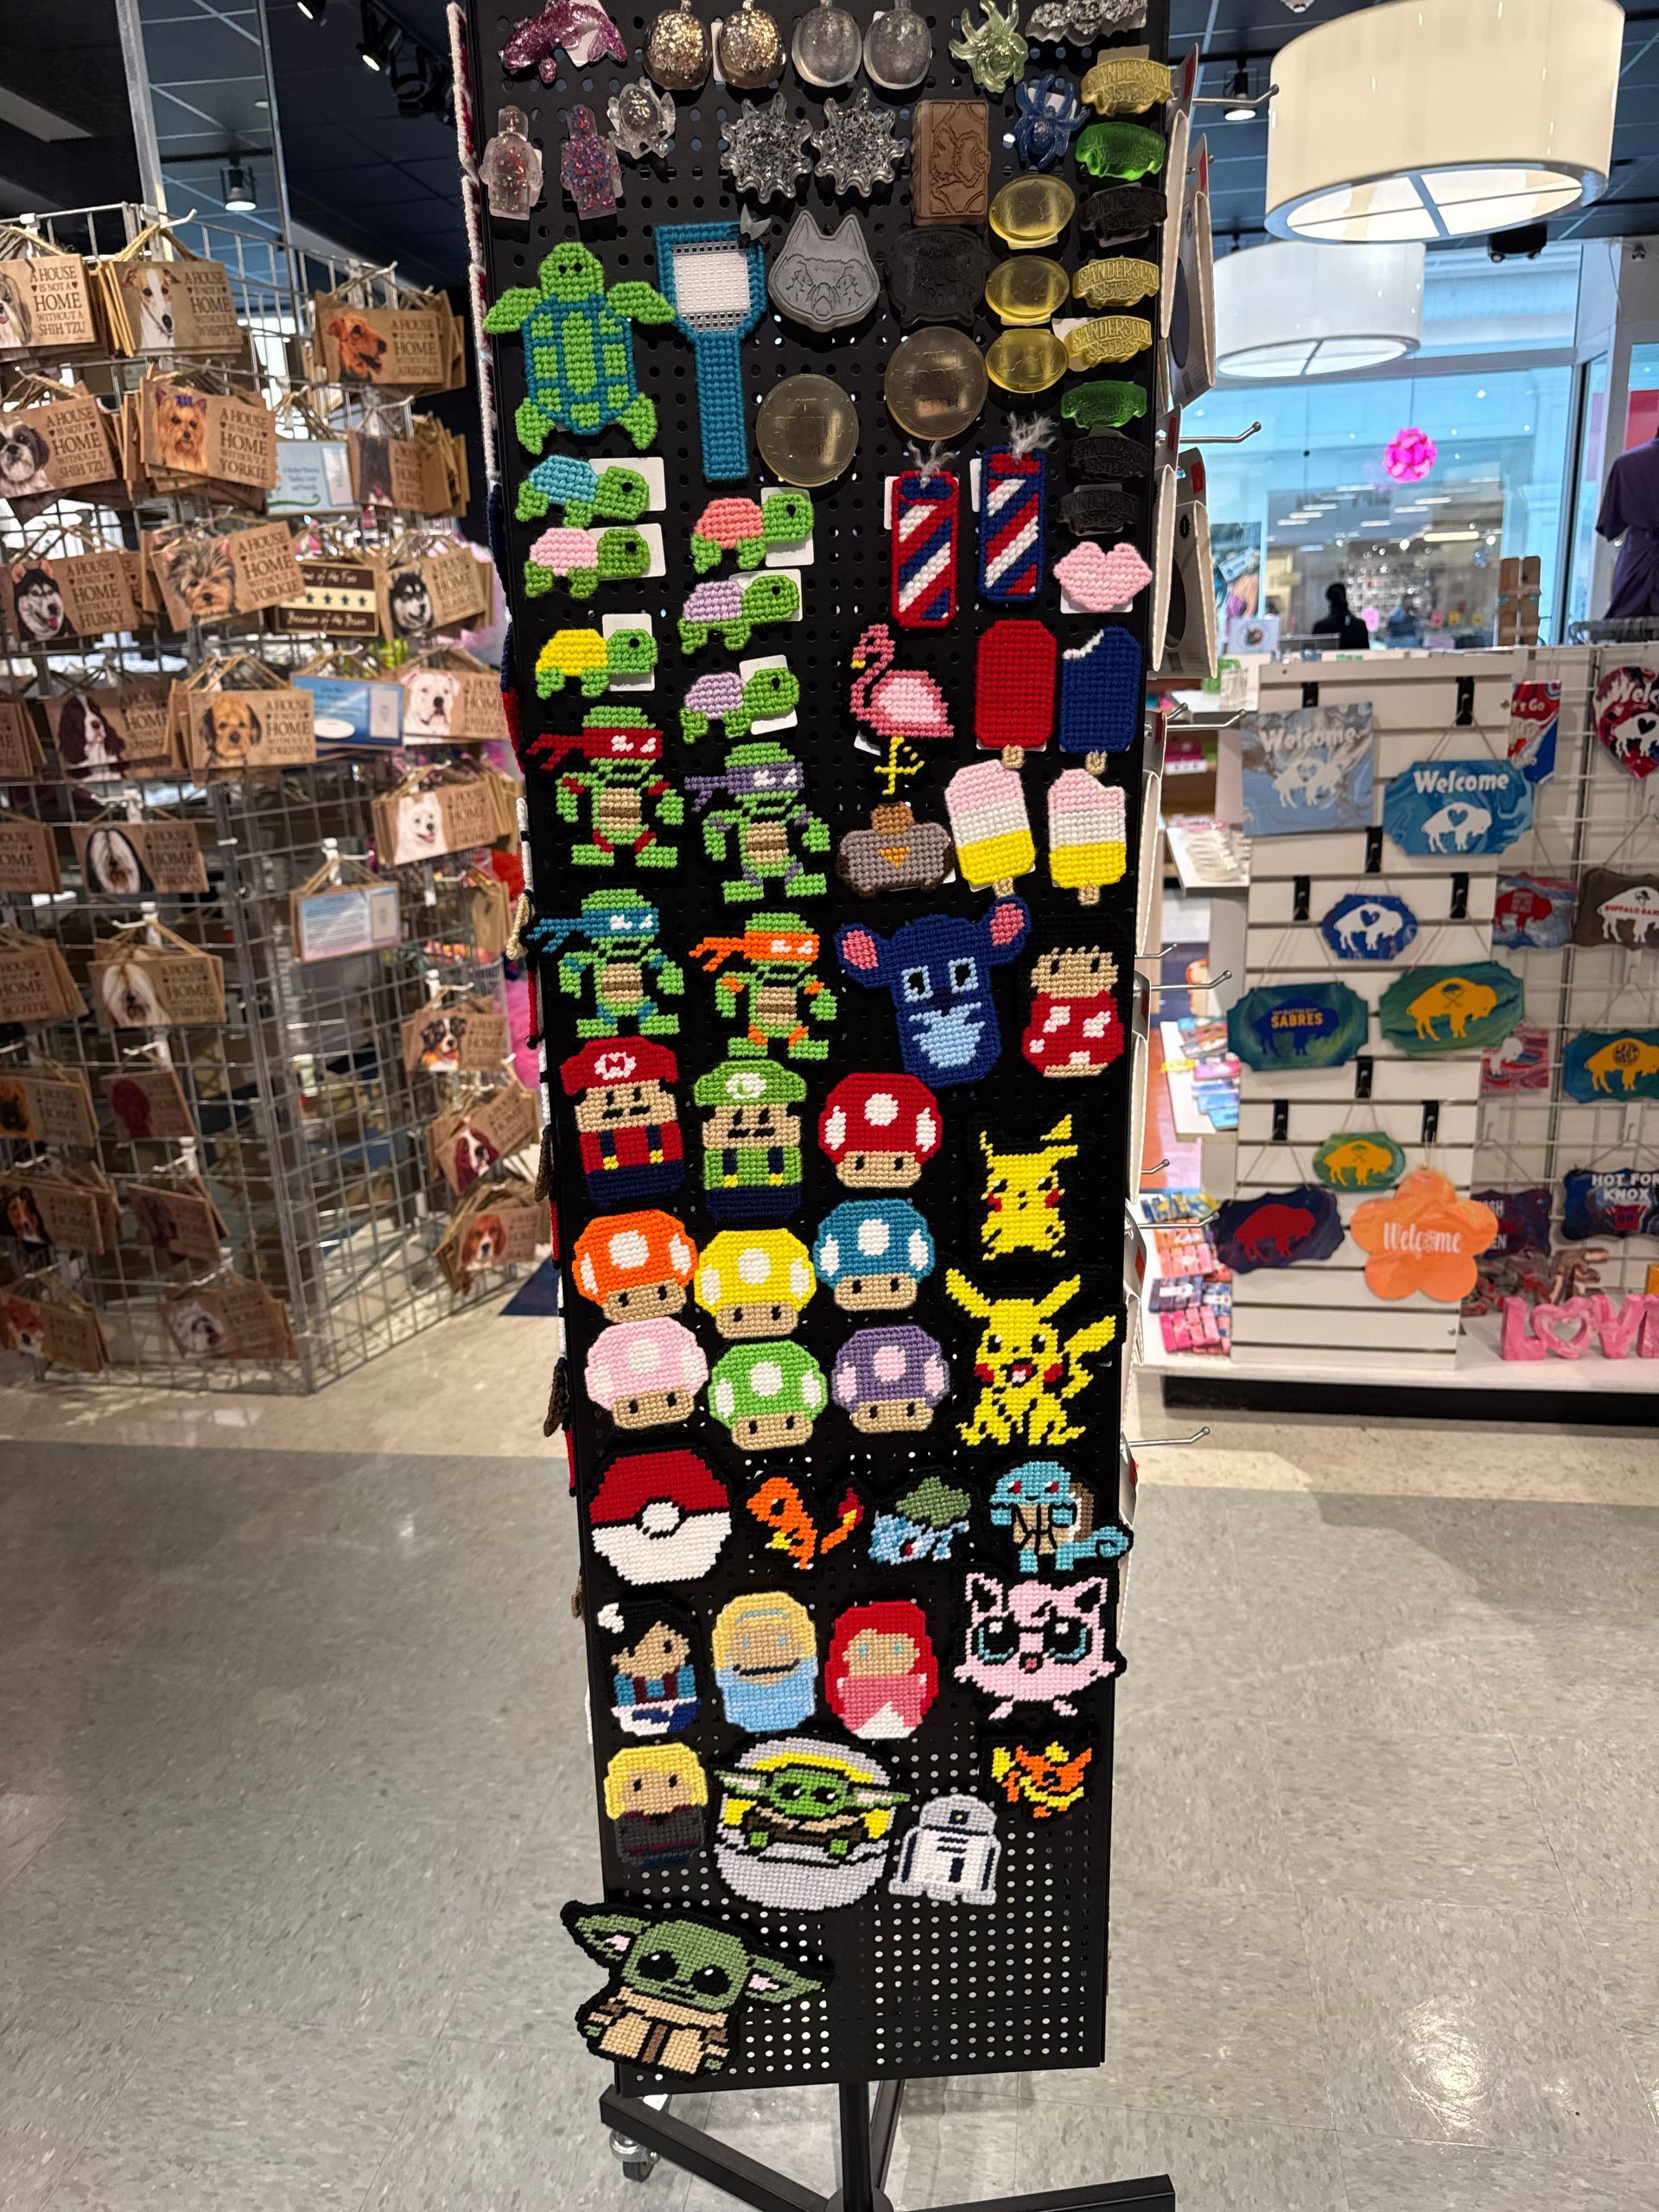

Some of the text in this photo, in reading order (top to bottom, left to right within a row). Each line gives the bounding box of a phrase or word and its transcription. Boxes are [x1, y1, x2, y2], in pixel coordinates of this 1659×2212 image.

[1087, 60, 1170, 93] SANDERSON
[39, 265, 78, 283] HOUSE
[1078, 261, 1158, 289] SANDERSON
[1094, 280, 1144, 298] SISTERS
[33, 292, 82, 312] HOME
[188, 296, 232, 314] HOME
[36, 312, 76, 322] WITHOUT
[38, 321, 86, 337] SHIH TZU
[1072, 318, 1148, 352] SANDERSON
[393, 341, 437, 355] HOME
[1089, 339, 1138, 357] SISTERS
[55, 406, 95, 426] HOUSE
[230, 410, 268, 430] HOUSE
[52, 431, 103, 456] HOME
[219, 430, 269, 457] HOME
[219, 457, 268, 480] YORKIE
[243, 554, 296, 581] HOME
[72, 582, 121, 604] HOME
[250, 579, 300, 603] YORKIE
[79, 610, 124, 629] HUSKY
[265, 720, 310, 736] HOME
[1258, 723, 1357, 753] Welcome
[1413, 769, 1510, 795] Welcome
[0, 854, 36, 867] OME
[1604, 905, 1639, 914] BUFFALO
[1271, 1012, 1323, 1029] SABRES
[1592, 1173, 1659, 1186] HOT FOR
[1603, 1187, 1649, 1202] KNOX
[1383, 1222, 1462, 1259] Welcome
